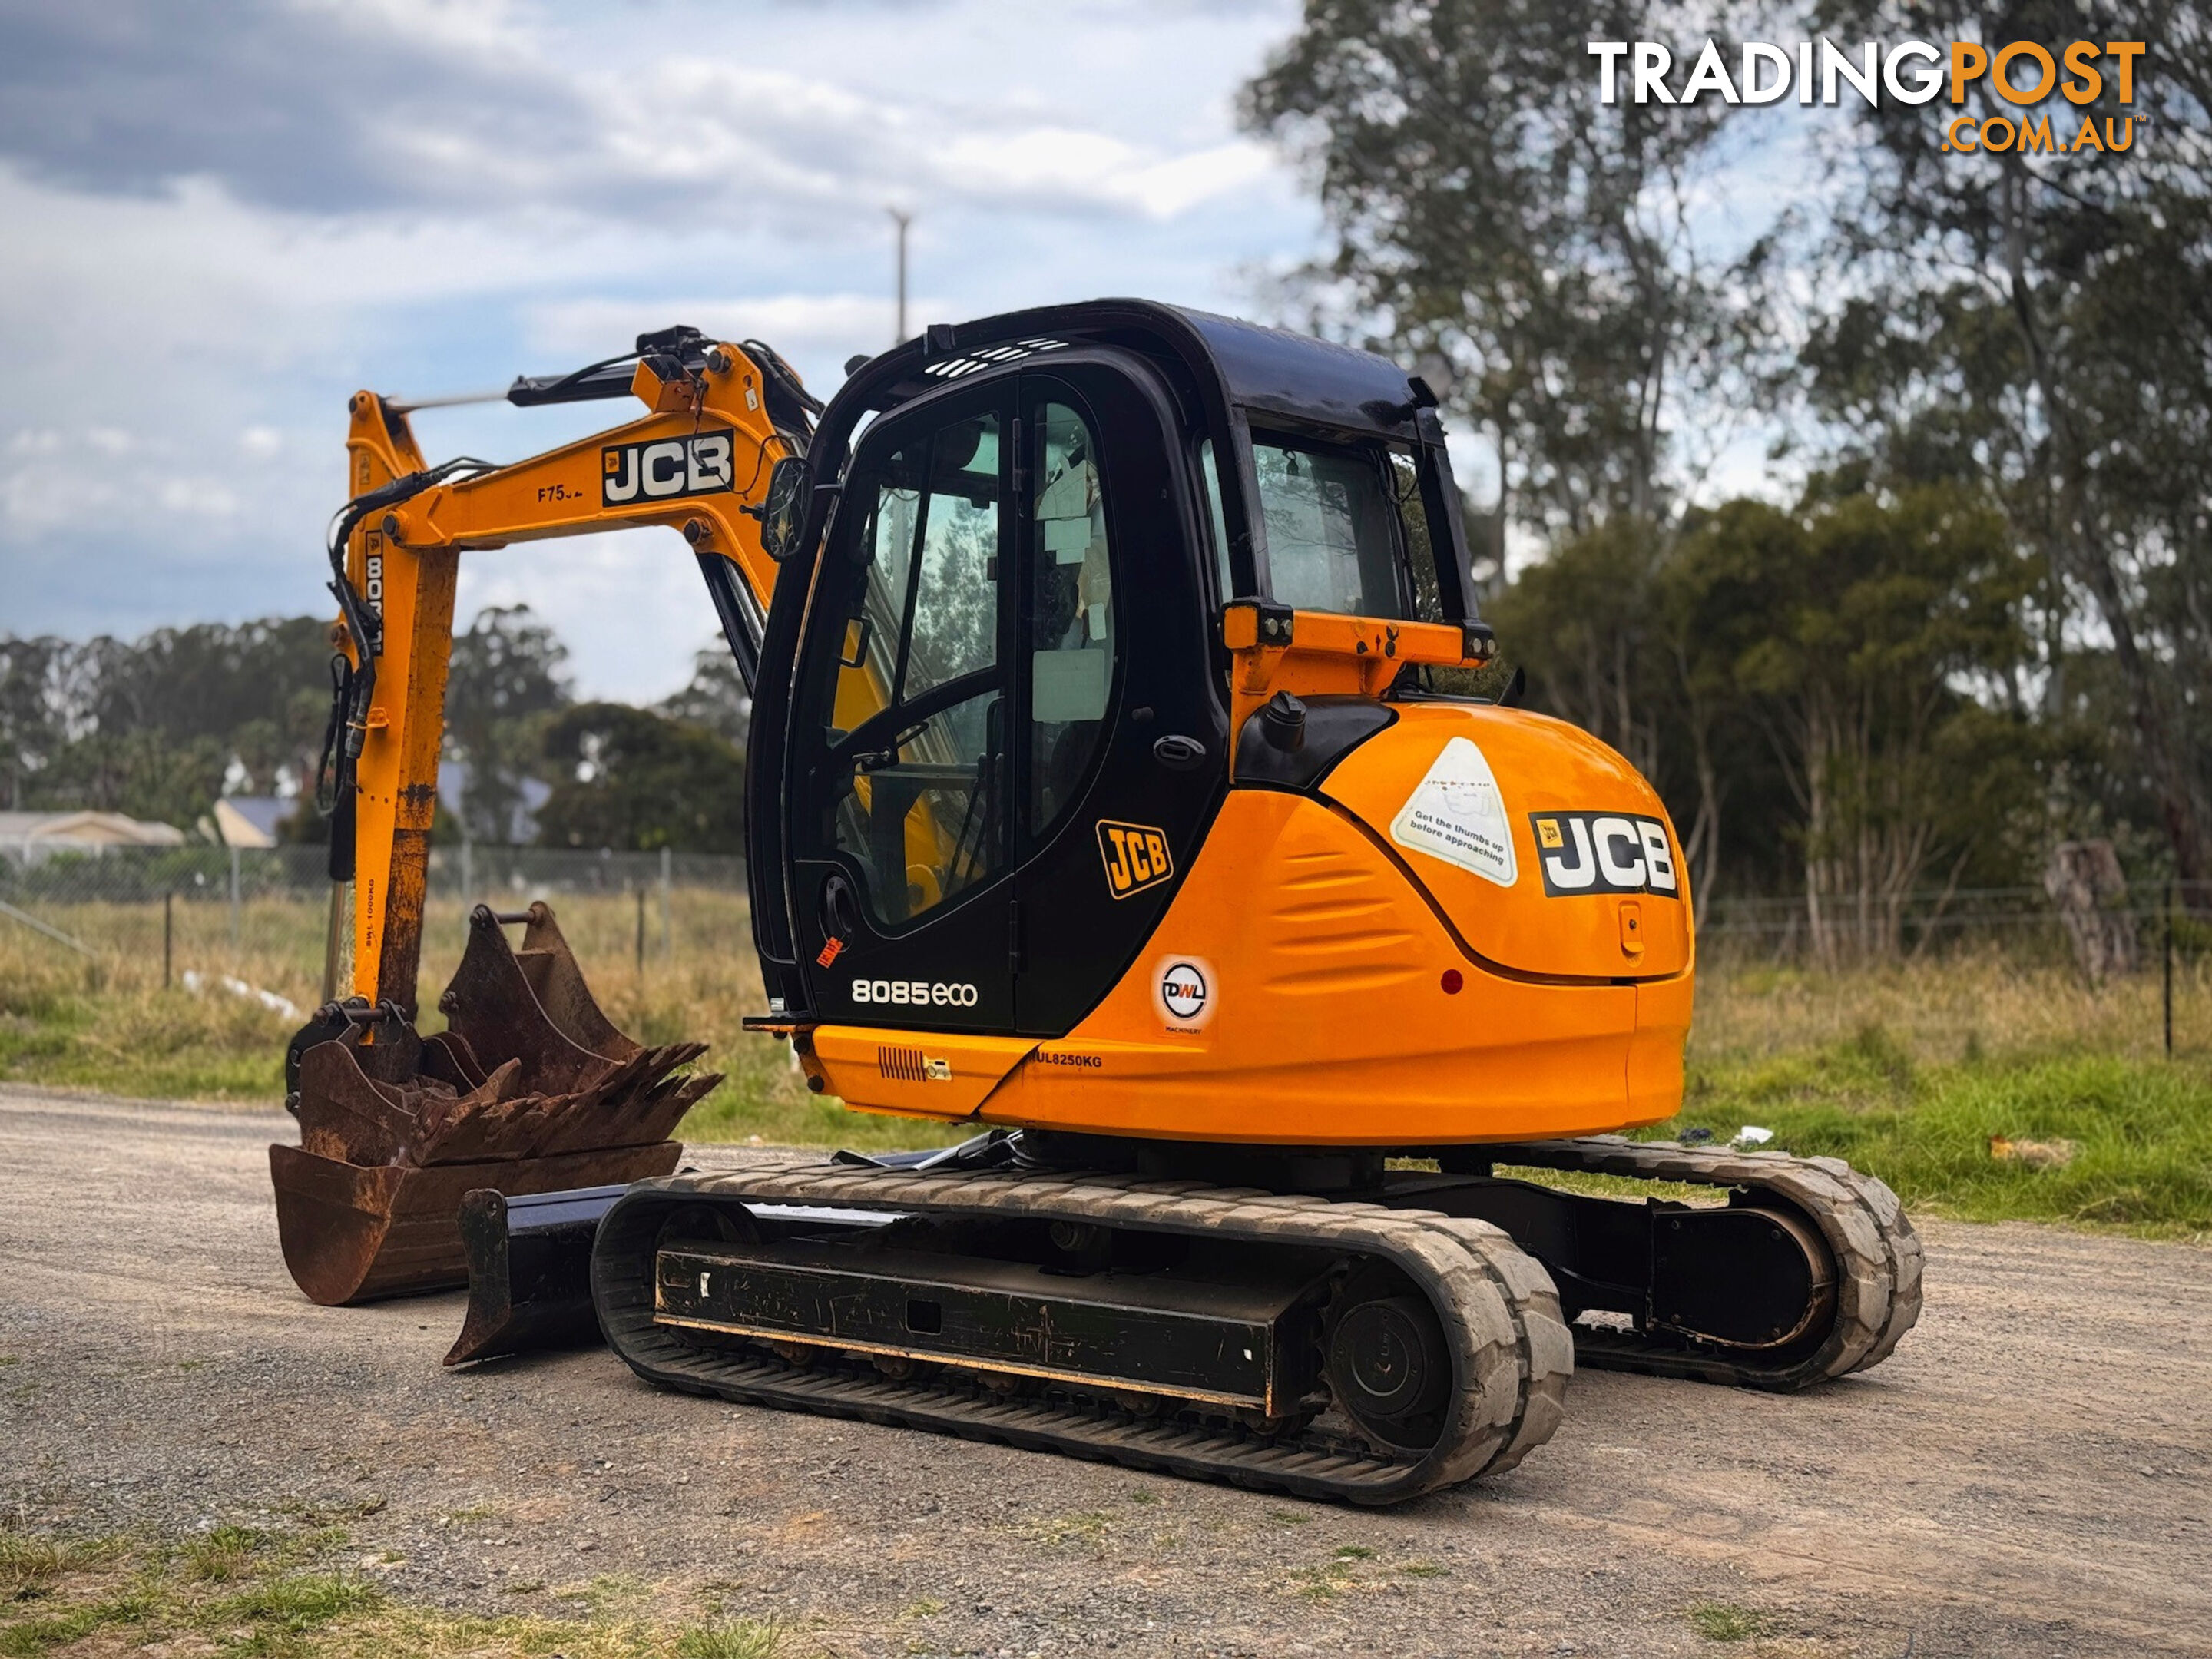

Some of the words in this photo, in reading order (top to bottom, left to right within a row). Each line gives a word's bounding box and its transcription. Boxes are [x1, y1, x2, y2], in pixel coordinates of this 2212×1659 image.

[605, 435, 732, 502] JCB
[1410, 820, 1442, 838] before
[1445, 833, 1504, 866] approaching
[1415, 810, 1433, 823] Get
[1435, 817, 1452, 830] the
[1455, 824, 1489, 846] thumbs
[1492, 841, 1504, 853] up
[1545, 817, 1676, 890] JCB
[1108, 829, 1167, 890] JCB
[1163, 982, 1206, 999] DWL
[1166, 1026, 1202, 1035] MACHINERY
